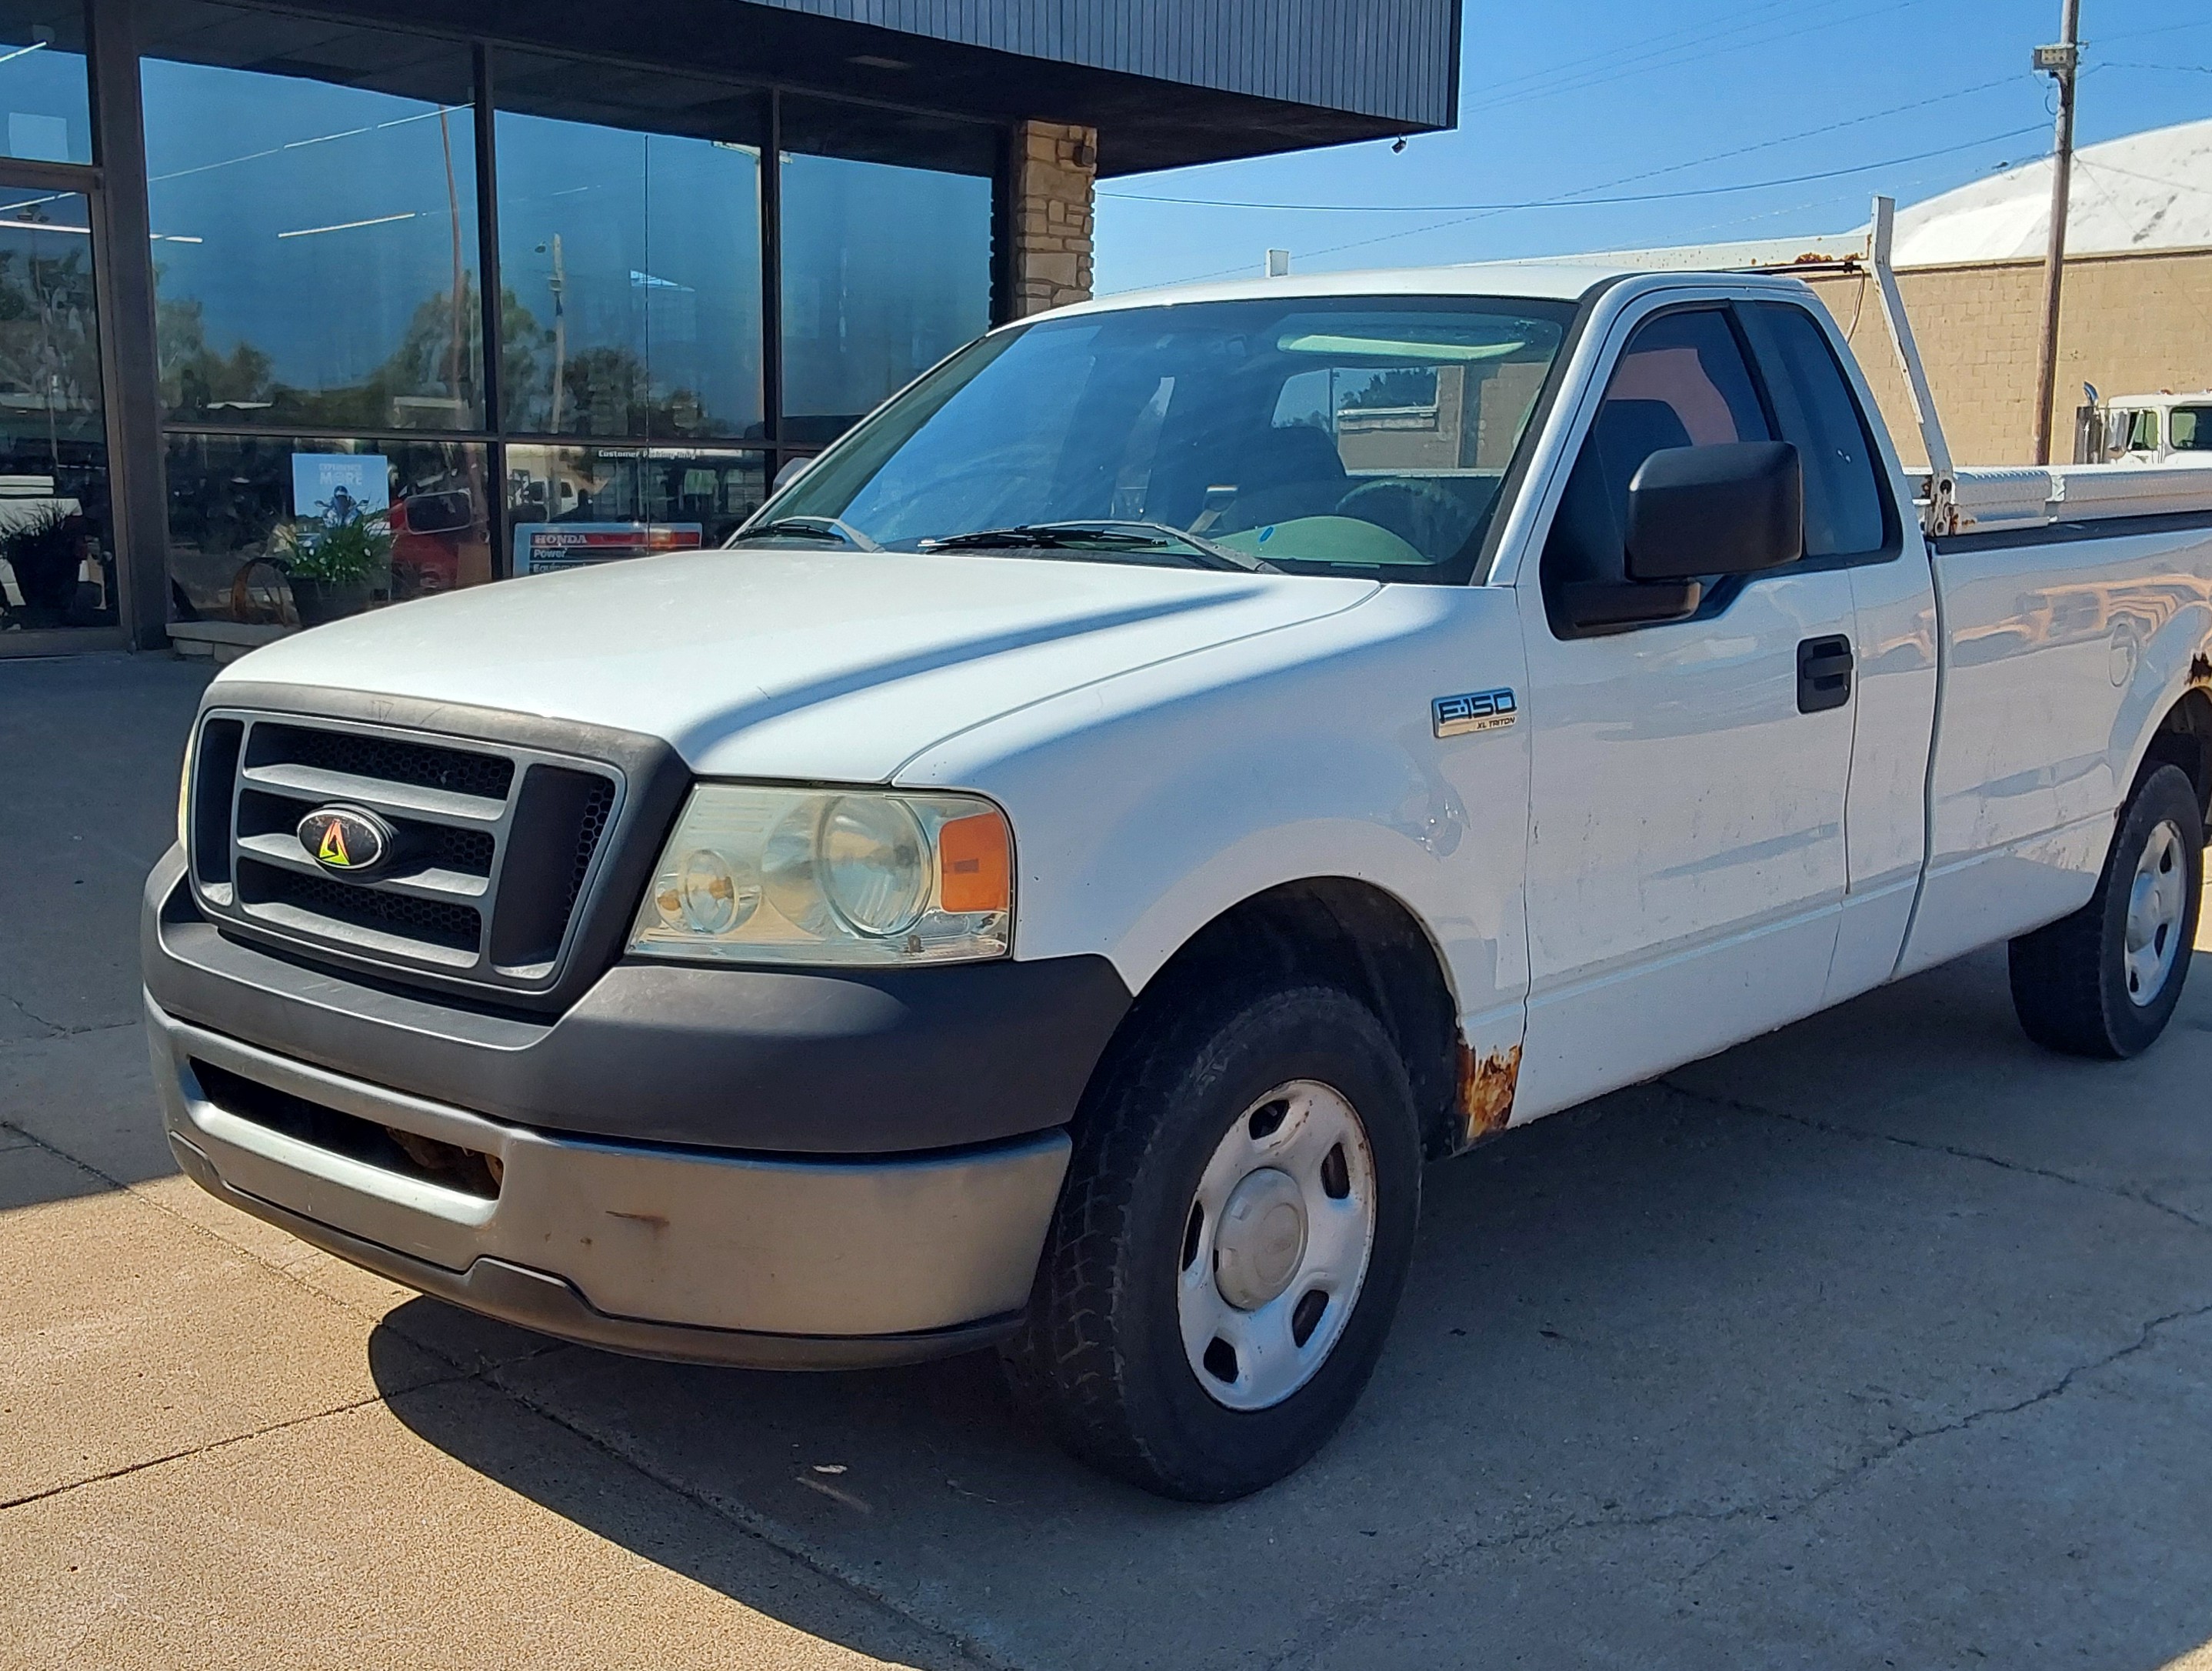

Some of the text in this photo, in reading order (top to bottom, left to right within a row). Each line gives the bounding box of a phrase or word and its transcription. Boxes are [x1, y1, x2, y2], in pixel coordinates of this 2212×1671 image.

[598, 449, 639, 458] Customer
[534, 535, 588, 544] HONDA
[534, 549, 566, 559] Power
[1438, 691, 1517, 724] F-150
[1477, 716, 1515, 729] XL TRITON
